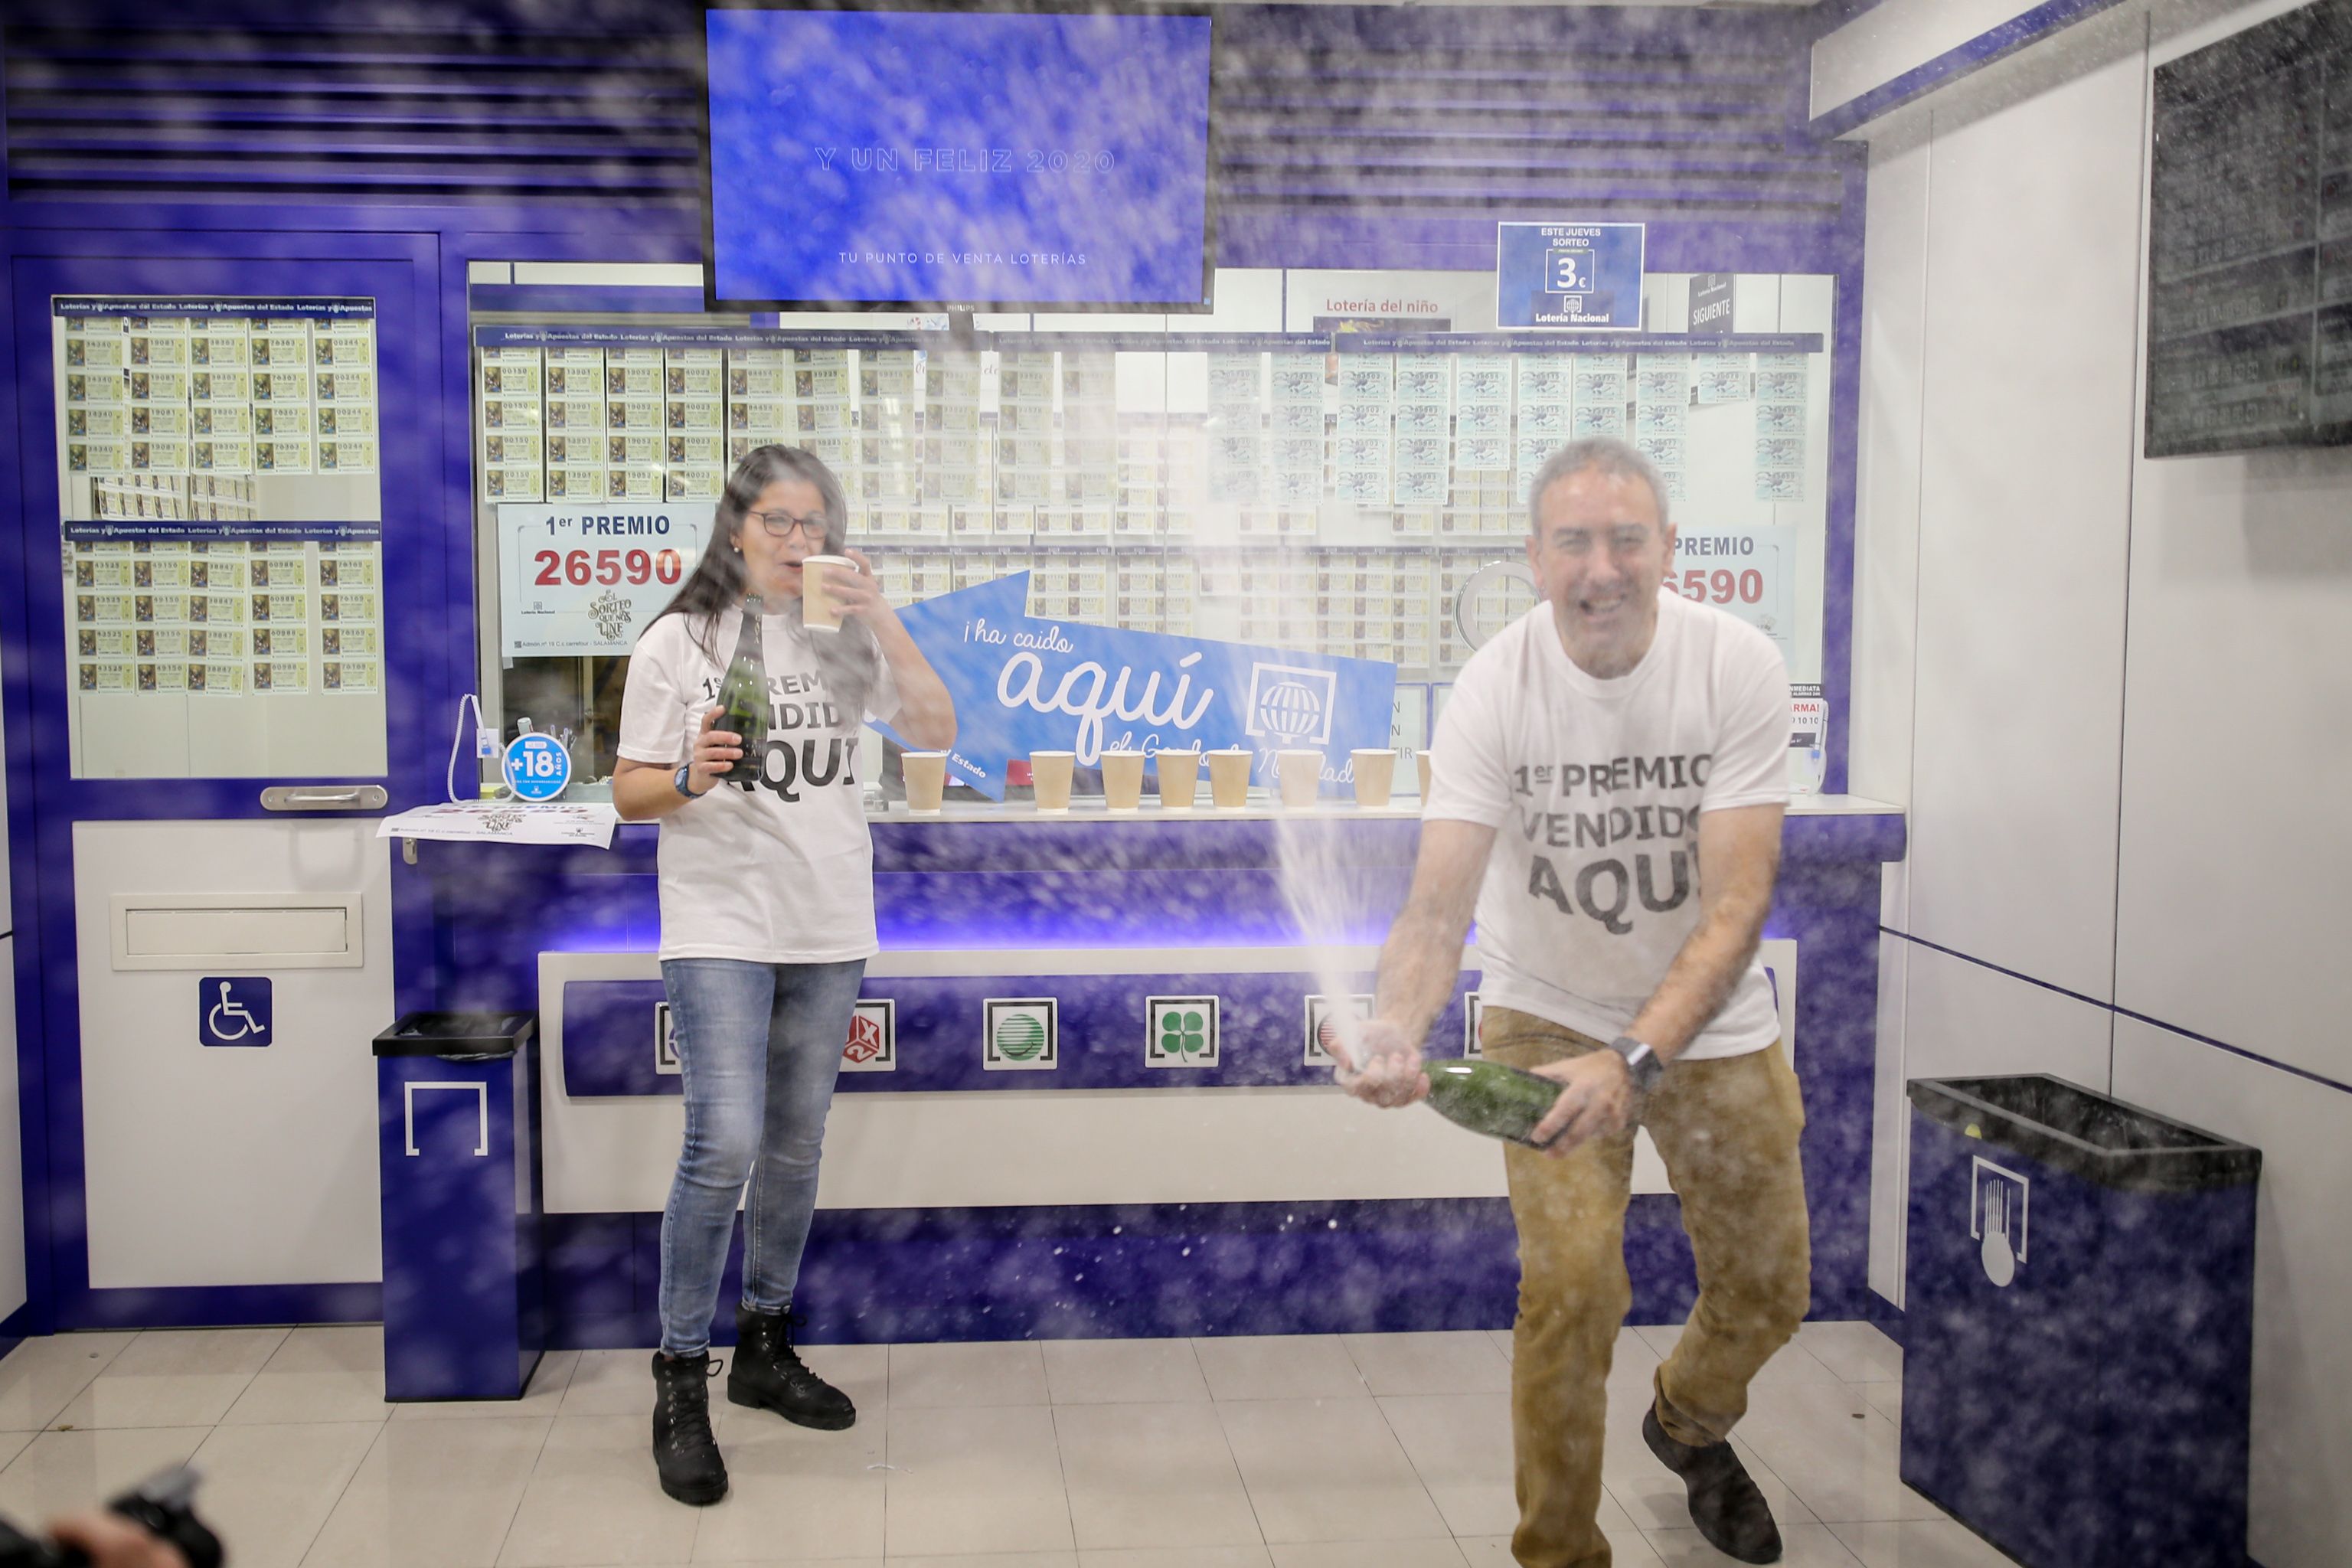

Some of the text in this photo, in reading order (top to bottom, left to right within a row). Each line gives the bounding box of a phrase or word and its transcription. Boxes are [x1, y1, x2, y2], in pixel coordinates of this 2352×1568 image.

[815, 147, 1115, 173] Y UN FELIZ 2020
[1541, 227, 1601, 237] ESTE JUEVES
[1553, 238, 1589, 247] SORTEO
[839, 251, 1086, 265] TU PUNTO DE VENTA LOTERÍAS
[1557, 257, 1586, 289] 3 €
[1326, 298, 1439, 313] Lotería del niño
[1693, 298, 1730, 325] SIGUIENTE
[1535, 312, 1609, 323] Lotería Nacional
[545, 514, 671, 536] 1er PREMIO
[1673, 536, 1754, 556] PREMIO
[534, 548, 682, 586] 26590
[598, 589, 617, 603] EL
[1661, 569, 1764, 604] 6590
[588, 599, 632, 619] SORTEO
[599, 612, 632, 623] QUE NOS
[595, 622, 623, 641] UNE
[766, 669, 824, 695] REM
[996, 650, 1215, 766] aquí
[952, 753, 986, 779] Estado
[1514, 753, 1712, 798] 1er PREMIO
